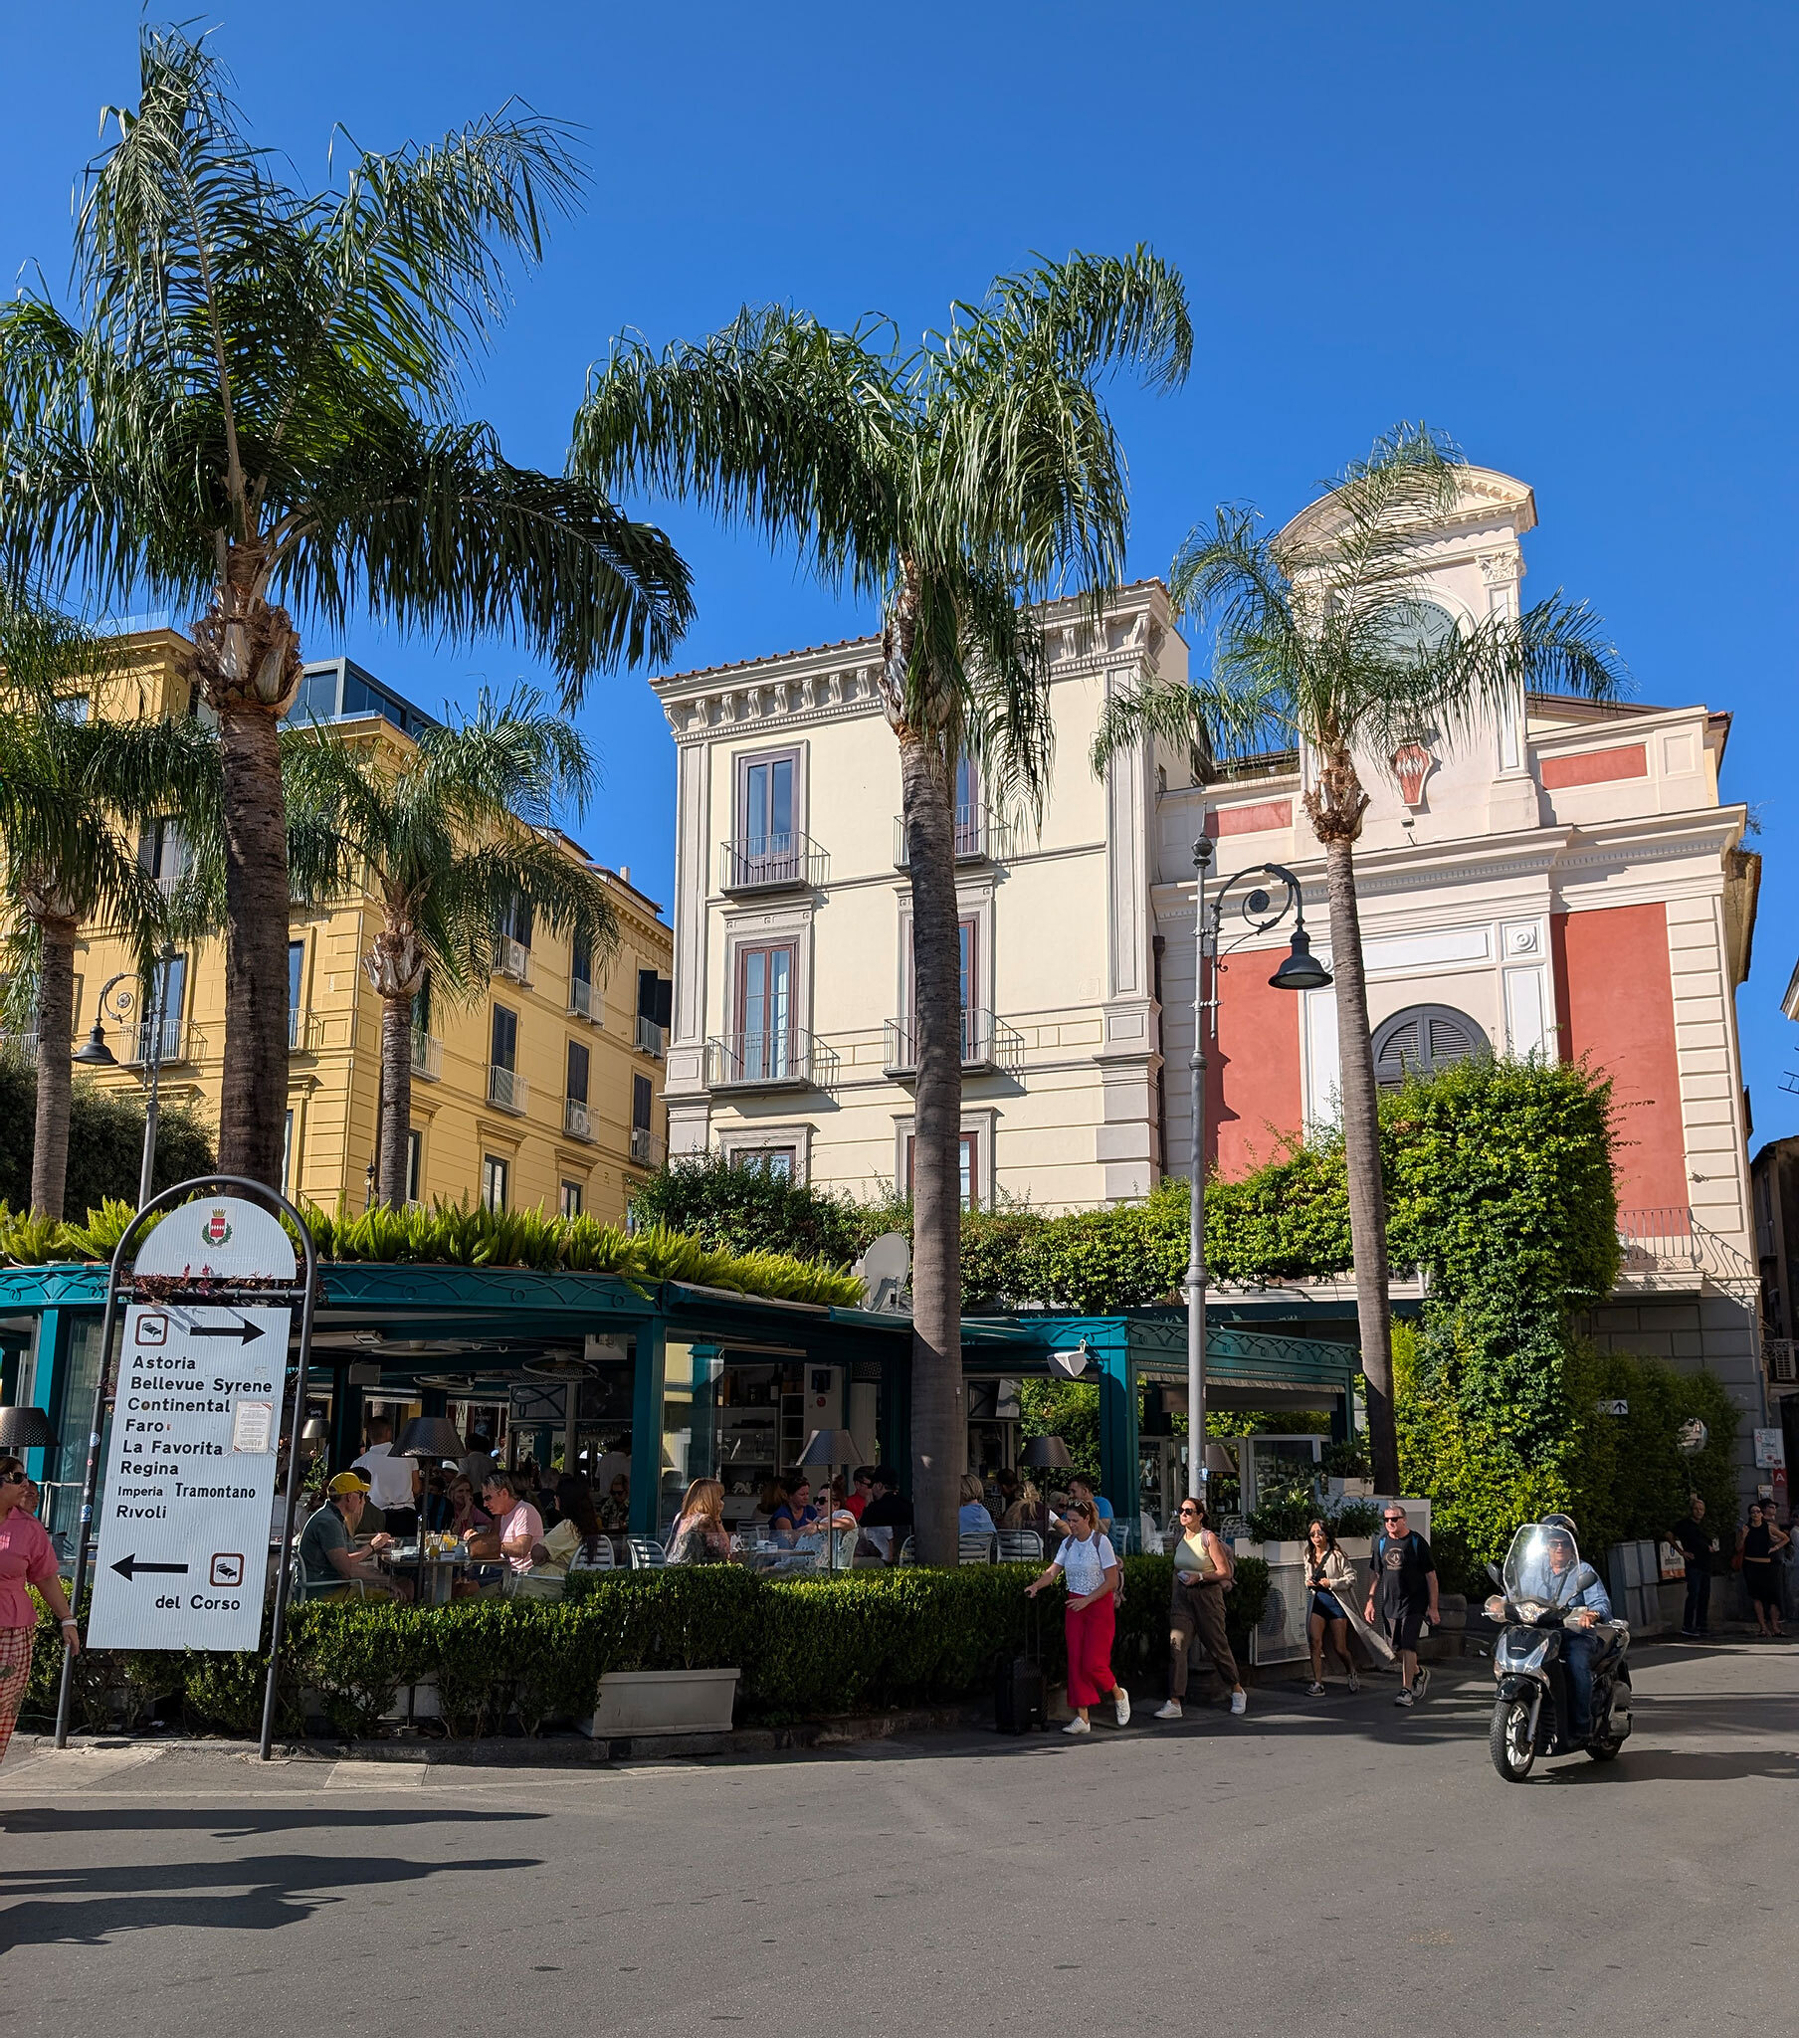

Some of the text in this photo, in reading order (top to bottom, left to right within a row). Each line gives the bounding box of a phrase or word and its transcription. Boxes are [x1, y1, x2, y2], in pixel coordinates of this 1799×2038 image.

[132, 1355, 196, 1370] Astoria
[130, 1376, 273, 1396] Bellevue Syrene
[127, 1397, 231, 1413] Continental
[125, 1418, 164, 1433] Faro
[122, 1439, 223, 1456] La Favorita
[120, 1460, 179, 1478] Regina
[175, 1482, 256, 1499] Tramontano
[116, 1504, 167, 1519] Rivoli
[155, 1594, 241, 1611] del Corso
